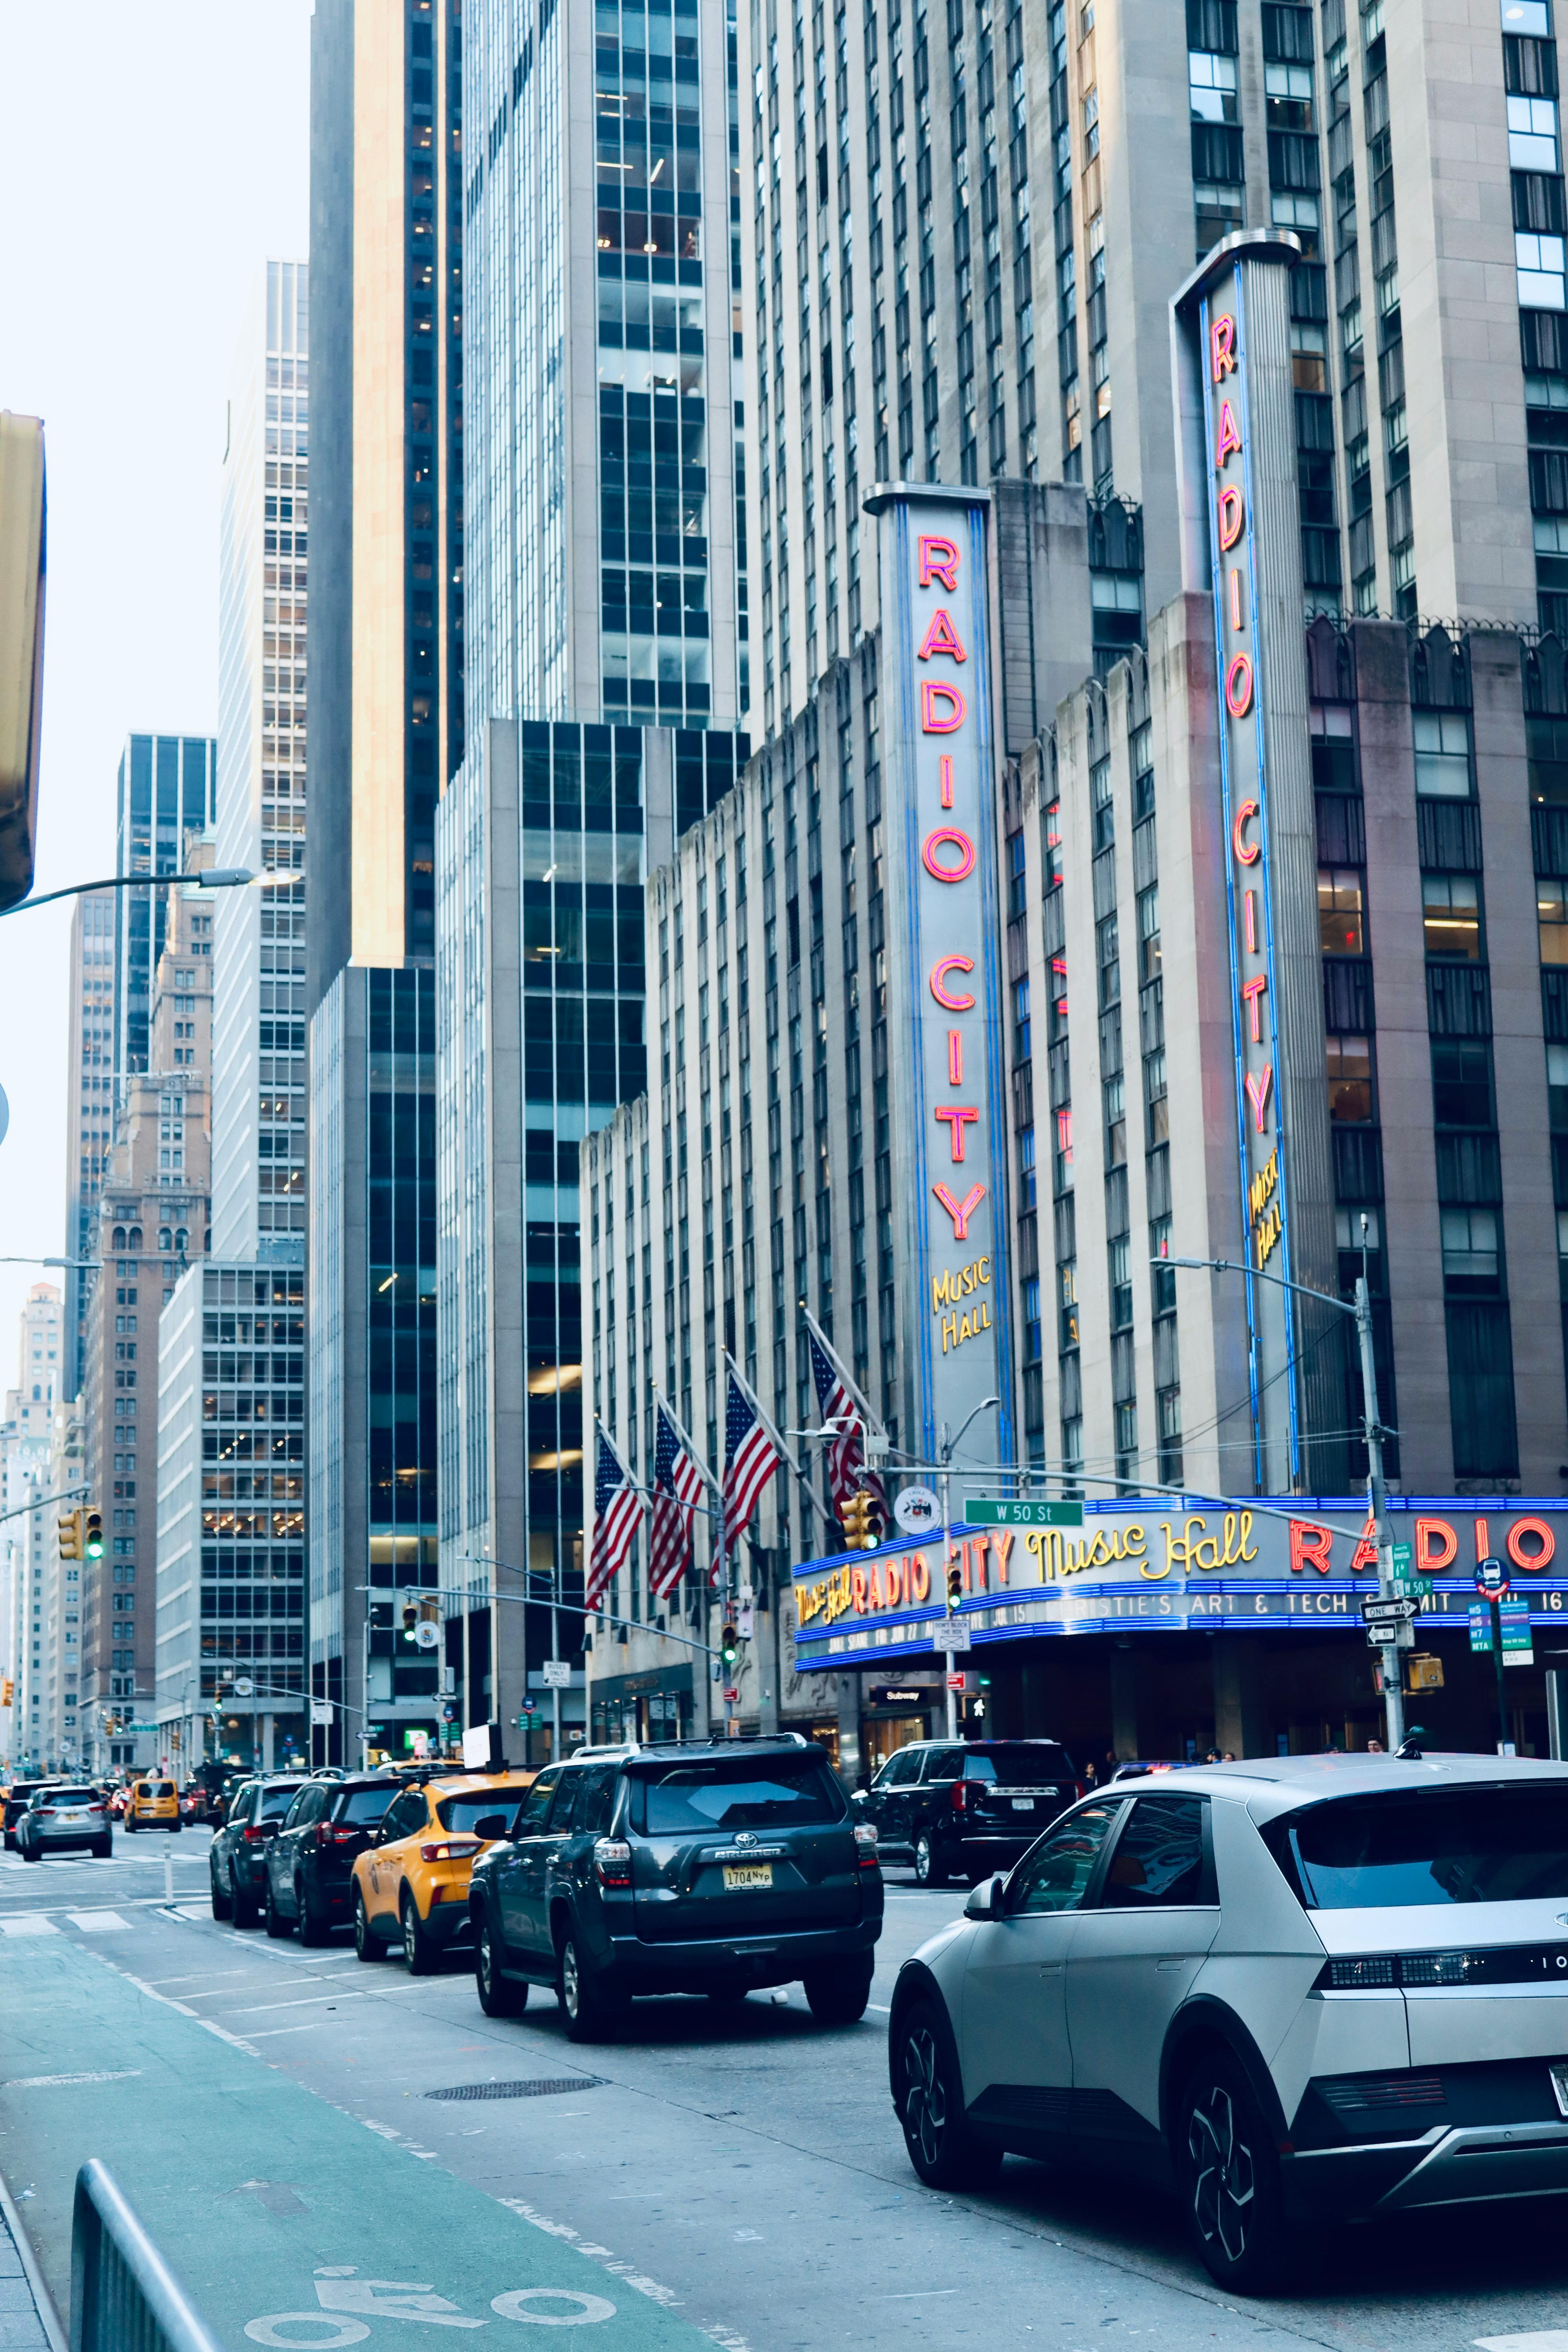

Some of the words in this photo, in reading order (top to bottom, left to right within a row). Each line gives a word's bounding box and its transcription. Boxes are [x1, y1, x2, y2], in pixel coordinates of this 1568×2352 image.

[1212, 313, 1253, 718] RADIO
[918, 535, 976, 883] RADIO
[1233, 799, 1271, 1134] CITY
[929, 954, 986, 1240] CITY
[1249, 1147, 1279, 1225] MUSIC
[933, 1256, 991, 1314] MUSIC
[942, 1302, 992, 1355] HALL
[996, 1505, 1007, 1520] W
[1013, 1506, 1031, 1521] 50
[1037, 1506, 1052, 1521] St
[1025, 1524, 1147, 1583] Music
[1140, 1510, 1258, 1579] Hall
[852, 1551, 929, 1614] RADIO
[943, 1529, 1013, 1590] ITY
[1404, 1582, 1410, 1593] W
[1413, 1581, 1424, 1594] 50
[1046, 1595, 1171, 1621] CHRISTIE'S
[1191, 1595, 1235, 1613] ART
[1256, 1595, 1268, 1613] &
[1287, 1594, 1347, 1613] TECH
[1370, 1608, 1387, 1617] ONE
[1394, 1604, 1411, 1613] WAY
[1469, 1605, 1481, 1614] M5
[1543, 1592, 1563, 1611] 16
[1013, 1605, 1025, 1623] 15
[1470, 1617, 1482, 1626] M5
[891, 1625, 905, 1644] JUN
[907, 1623, 918, 1640] 27
[1471, 1629, 1482, 1638] M7
[1472, 1642, 1488, 1650] MTA
[887, 1691, 920, 1701] Subway
